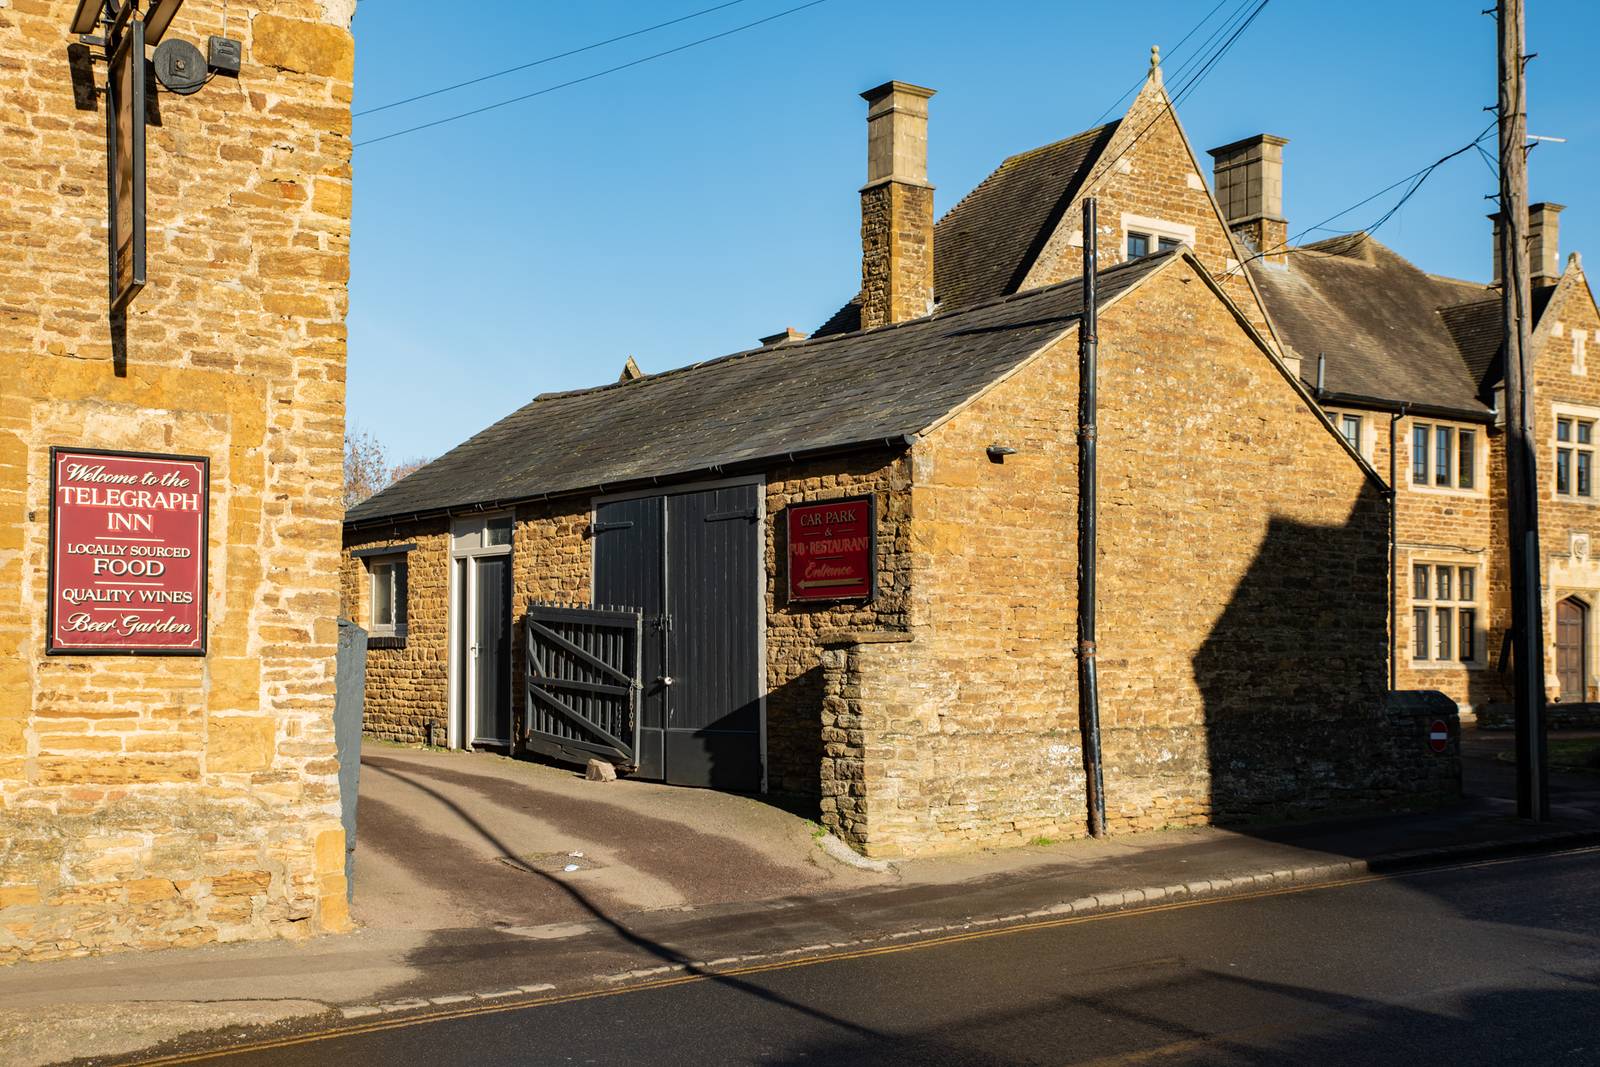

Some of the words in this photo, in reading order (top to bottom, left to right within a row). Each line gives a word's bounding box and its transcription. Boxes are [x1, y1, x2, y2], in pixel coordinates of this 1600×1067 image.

[67, 463, 137, 485] Welcome
[140, 472, 159, 486] to
[160, 471, 190, 488] the
[59, 486, 199, 511] TELEGRAPH
[107, 512, 153, 532] INN
[800, 513, 822, 527] CAR
[825, 509, 857, 523] PARK
[824, 527, 833, 537] &
[68, 543, 128, 556] LOCALLY
[130, 546, 191, 558] SOURCED
[93, 558, 165, 576] FOOD
[804, 562, 855, 578] Entrance
[62, 588, 135, 604] QUALITY
[139, 590, 193, 604] WINES
[61, 612, 117, 632] Beer
[117, 612, 192, 637] Garden
